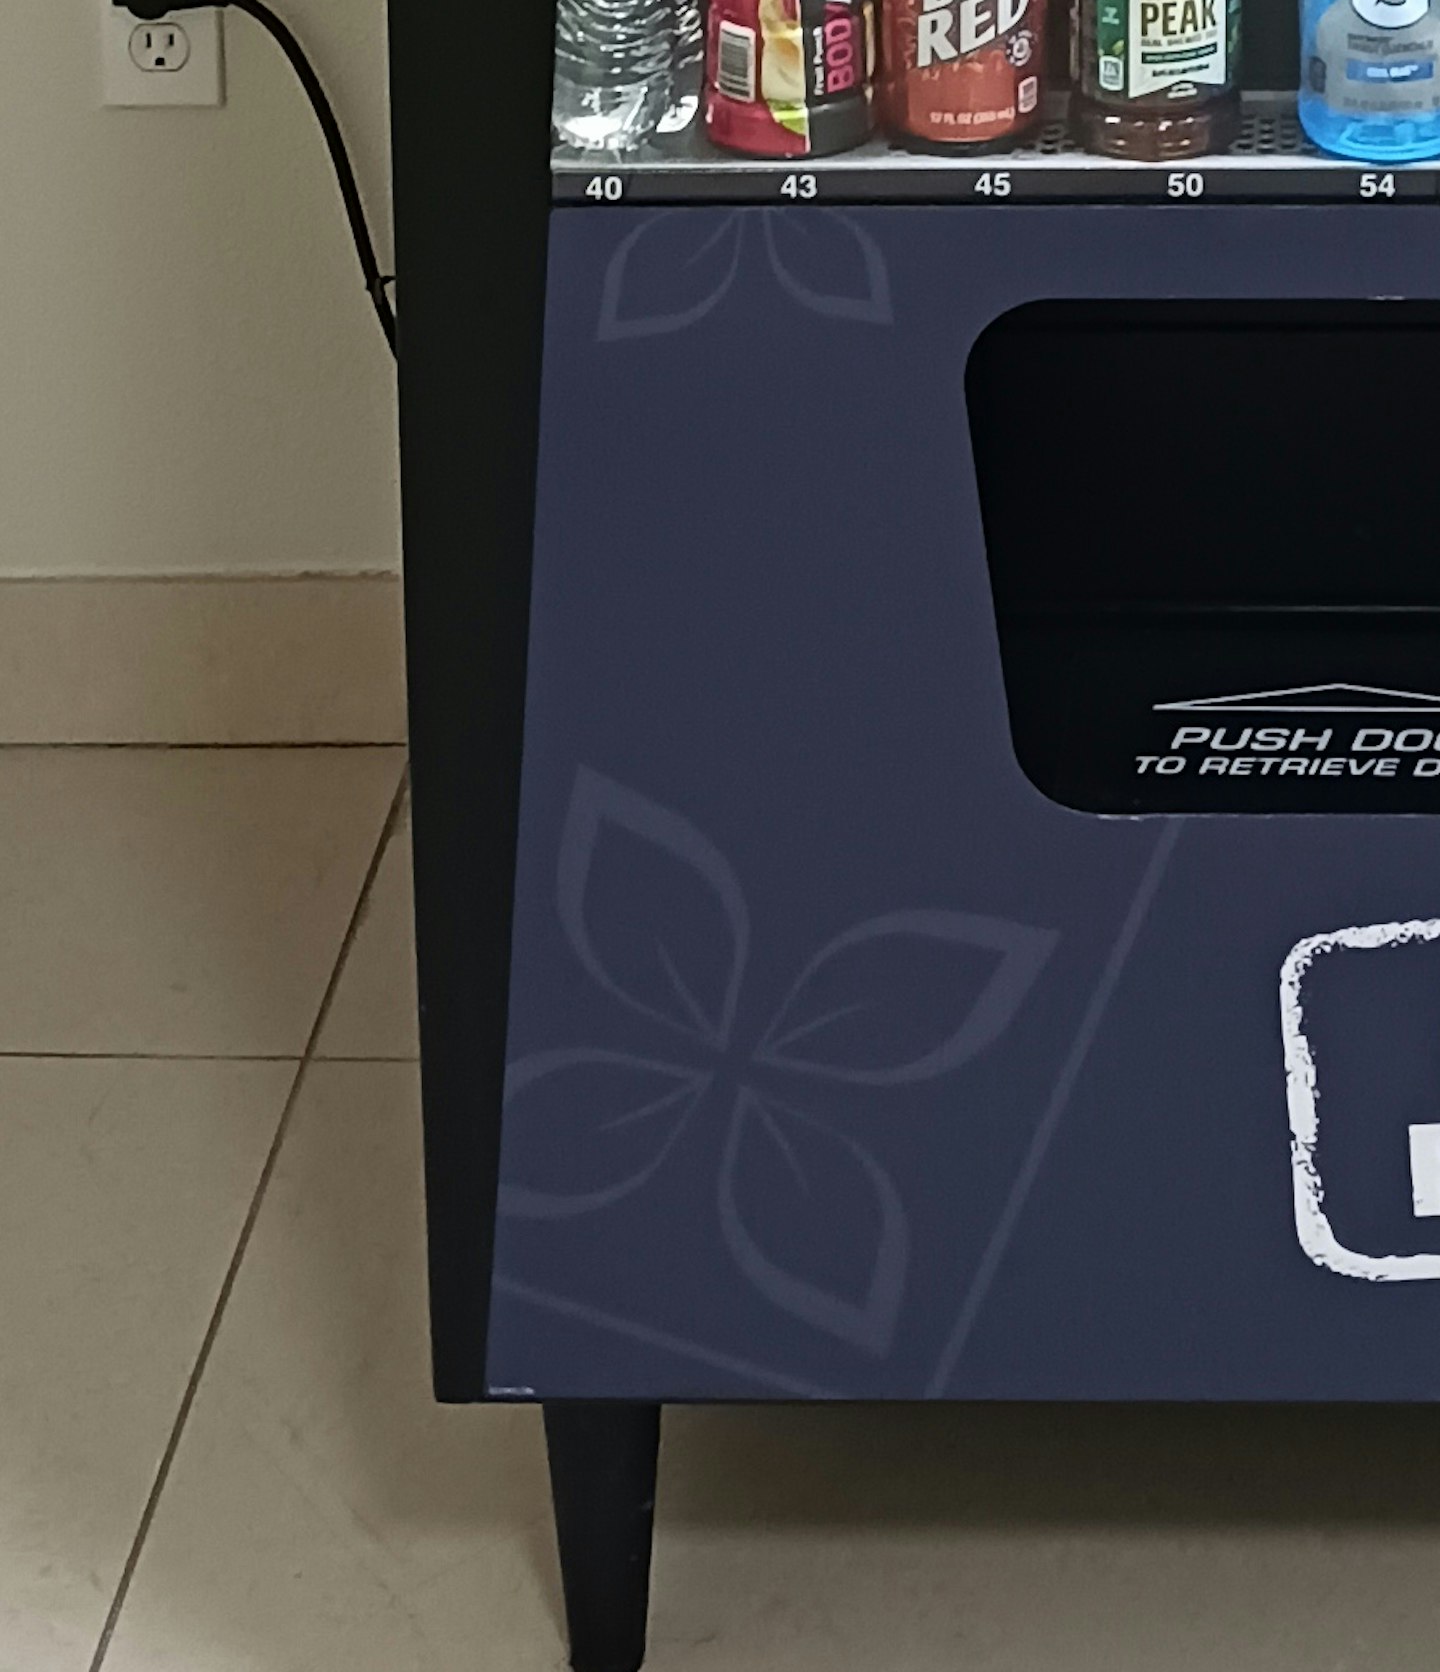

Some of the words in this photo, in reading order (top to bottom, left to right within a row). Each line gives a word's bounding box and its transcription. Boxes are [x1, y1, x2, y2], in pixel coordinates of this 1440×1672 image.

[586, 177, 623, 201] 40
[780, 175, 817, 199] 43
[974, 172, 1012, 196] 45
[1167, 173, 1204, 197] 50
[1359, 174, 1396, 198] 54
[1171, 727, 1333, 751] PUSH
[1135, 756, 1186, 774] TO
[1198, 757, 1402, 777] RETRIEVE
